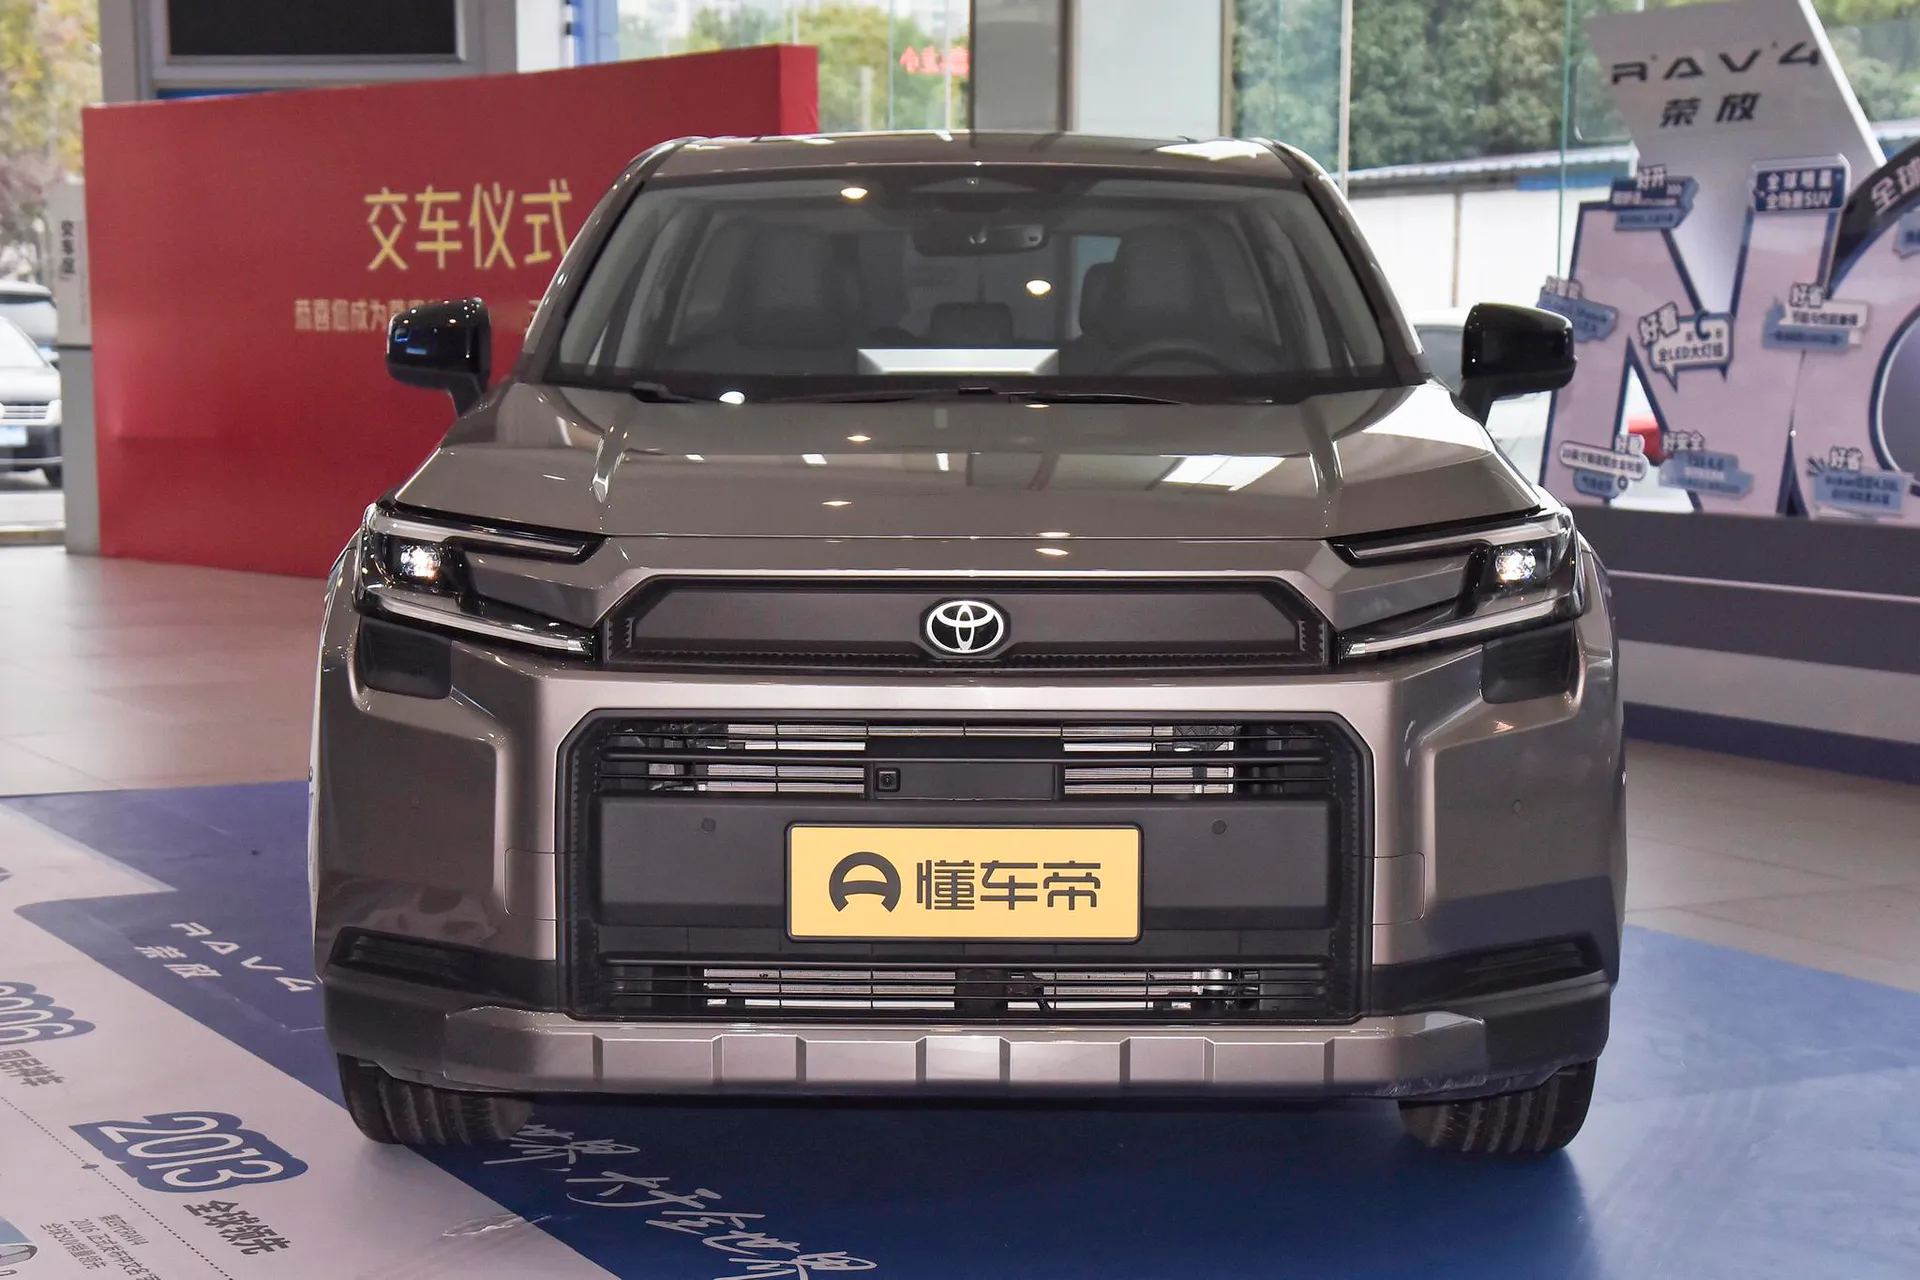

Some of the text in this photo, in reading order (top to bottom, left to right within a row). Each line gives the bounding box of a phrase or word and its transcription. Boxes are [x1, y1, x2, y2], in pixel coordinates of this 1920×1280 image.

[1612, 42, 1821, 85] RAV4
[1660, 92, 1762, 128] 荣放
[365, 180, 572, 271] 交车仪式
[916, 859, 1101, 911] 懂车帝
[97, 1116, 284, 1188] 2013
[182, 1200, 292, 1257] 全球领先
